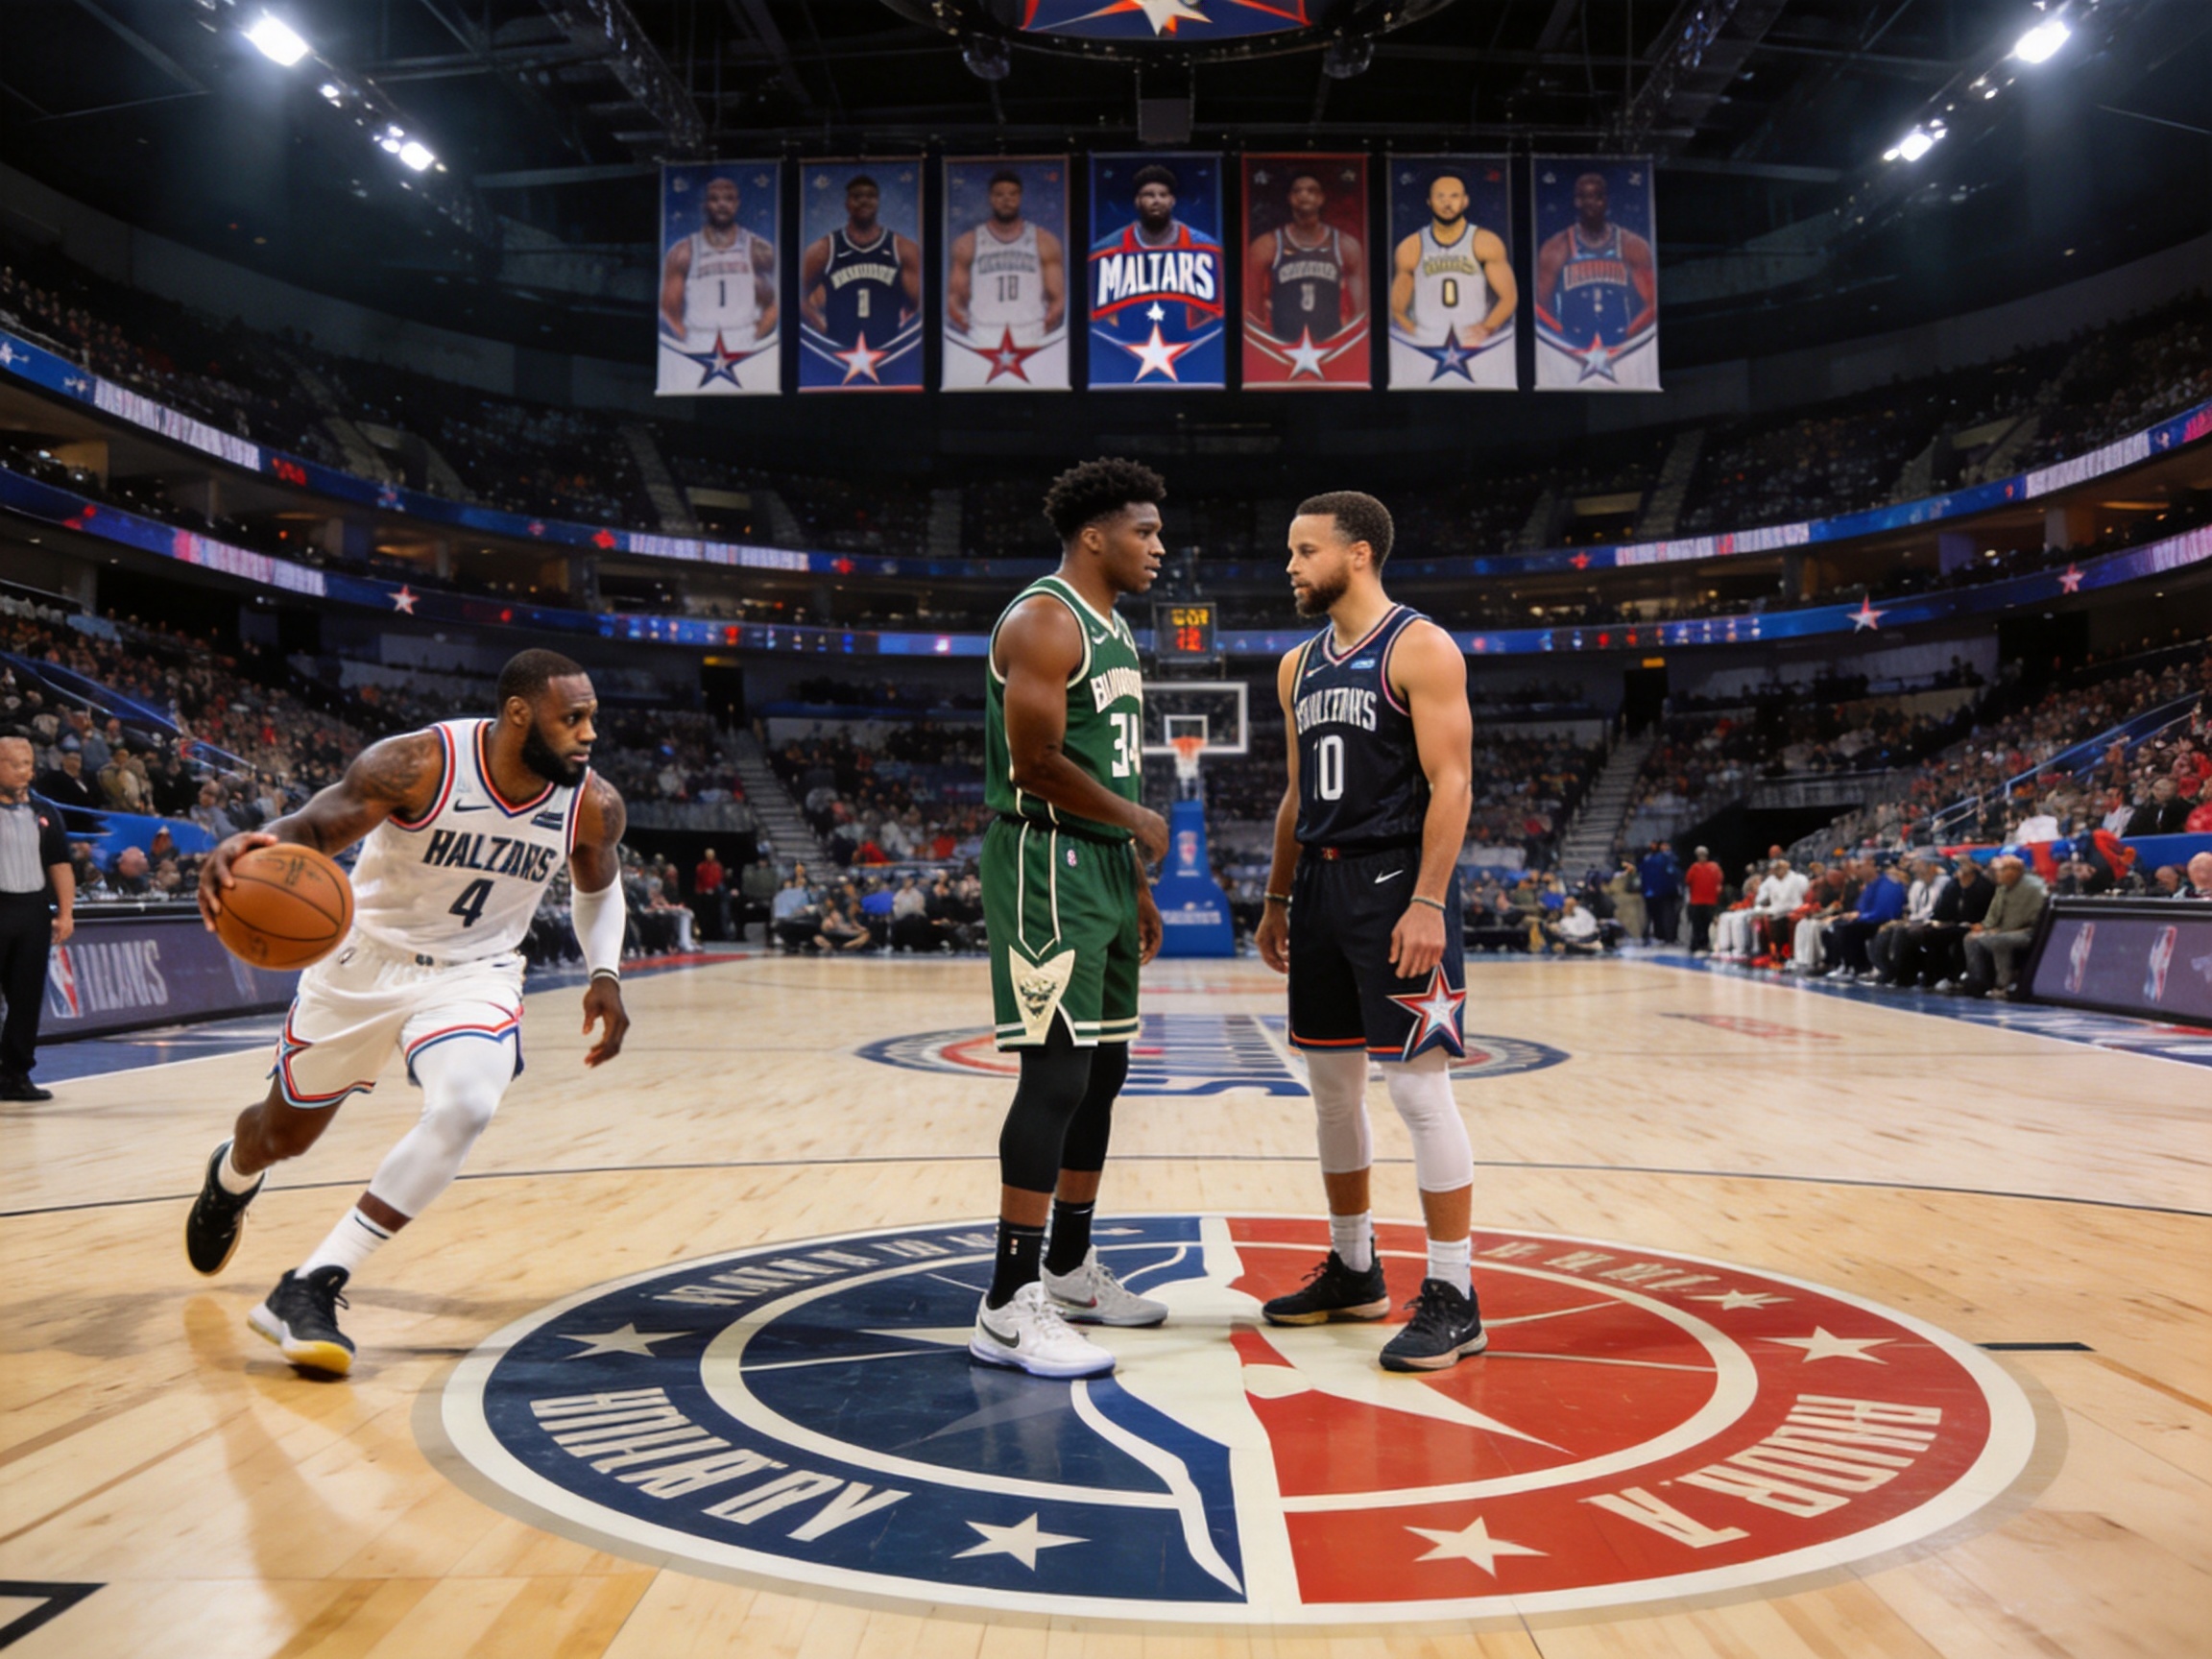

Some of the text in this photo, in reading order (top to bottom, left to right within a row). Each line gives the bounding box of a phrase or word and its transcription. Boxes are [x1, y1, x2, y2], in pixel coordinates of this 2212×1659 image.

[1097, 252, 1214, 306] MALTARS
[1442, 277, 1458, 308] 0
[447, 878, 495, 927] 4
